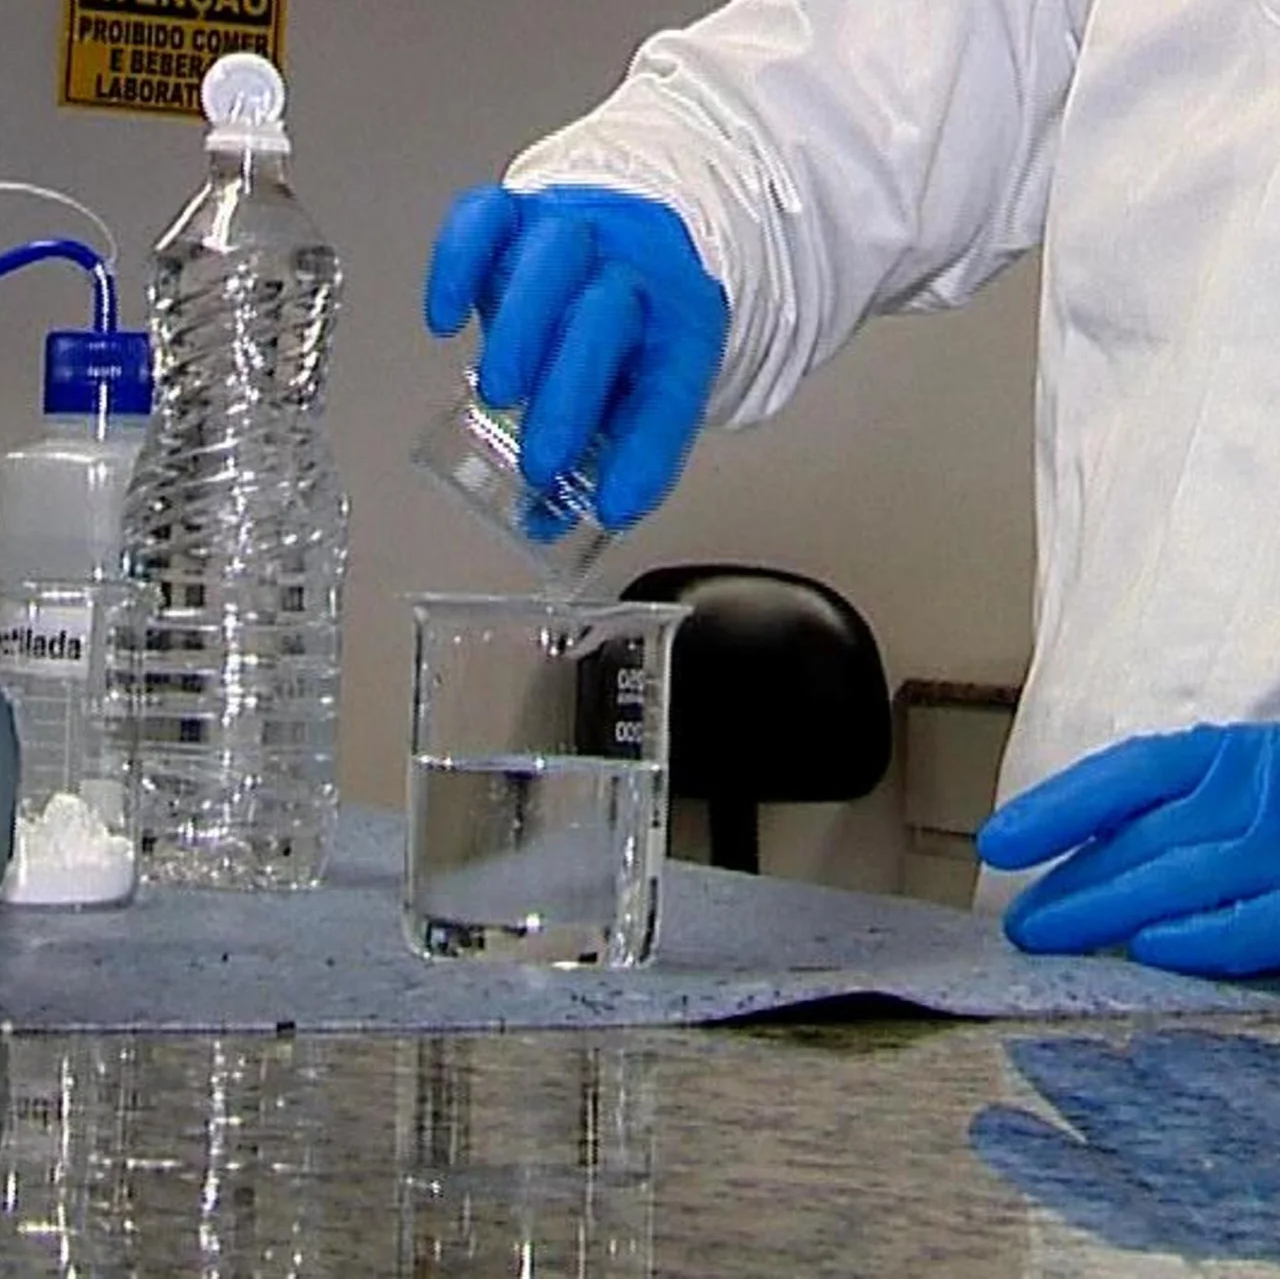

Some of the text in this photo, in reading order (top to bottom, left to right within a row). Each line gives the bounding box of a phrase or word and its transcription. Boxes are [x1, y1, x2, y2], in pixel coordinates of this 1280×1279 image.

[79, 17, 268, 54] PROIBIDO COMER
[110, 48, 124, 72] E
[130, 52, 205, 80] BEBER
[96, 74, 202, 109] LABORAT
